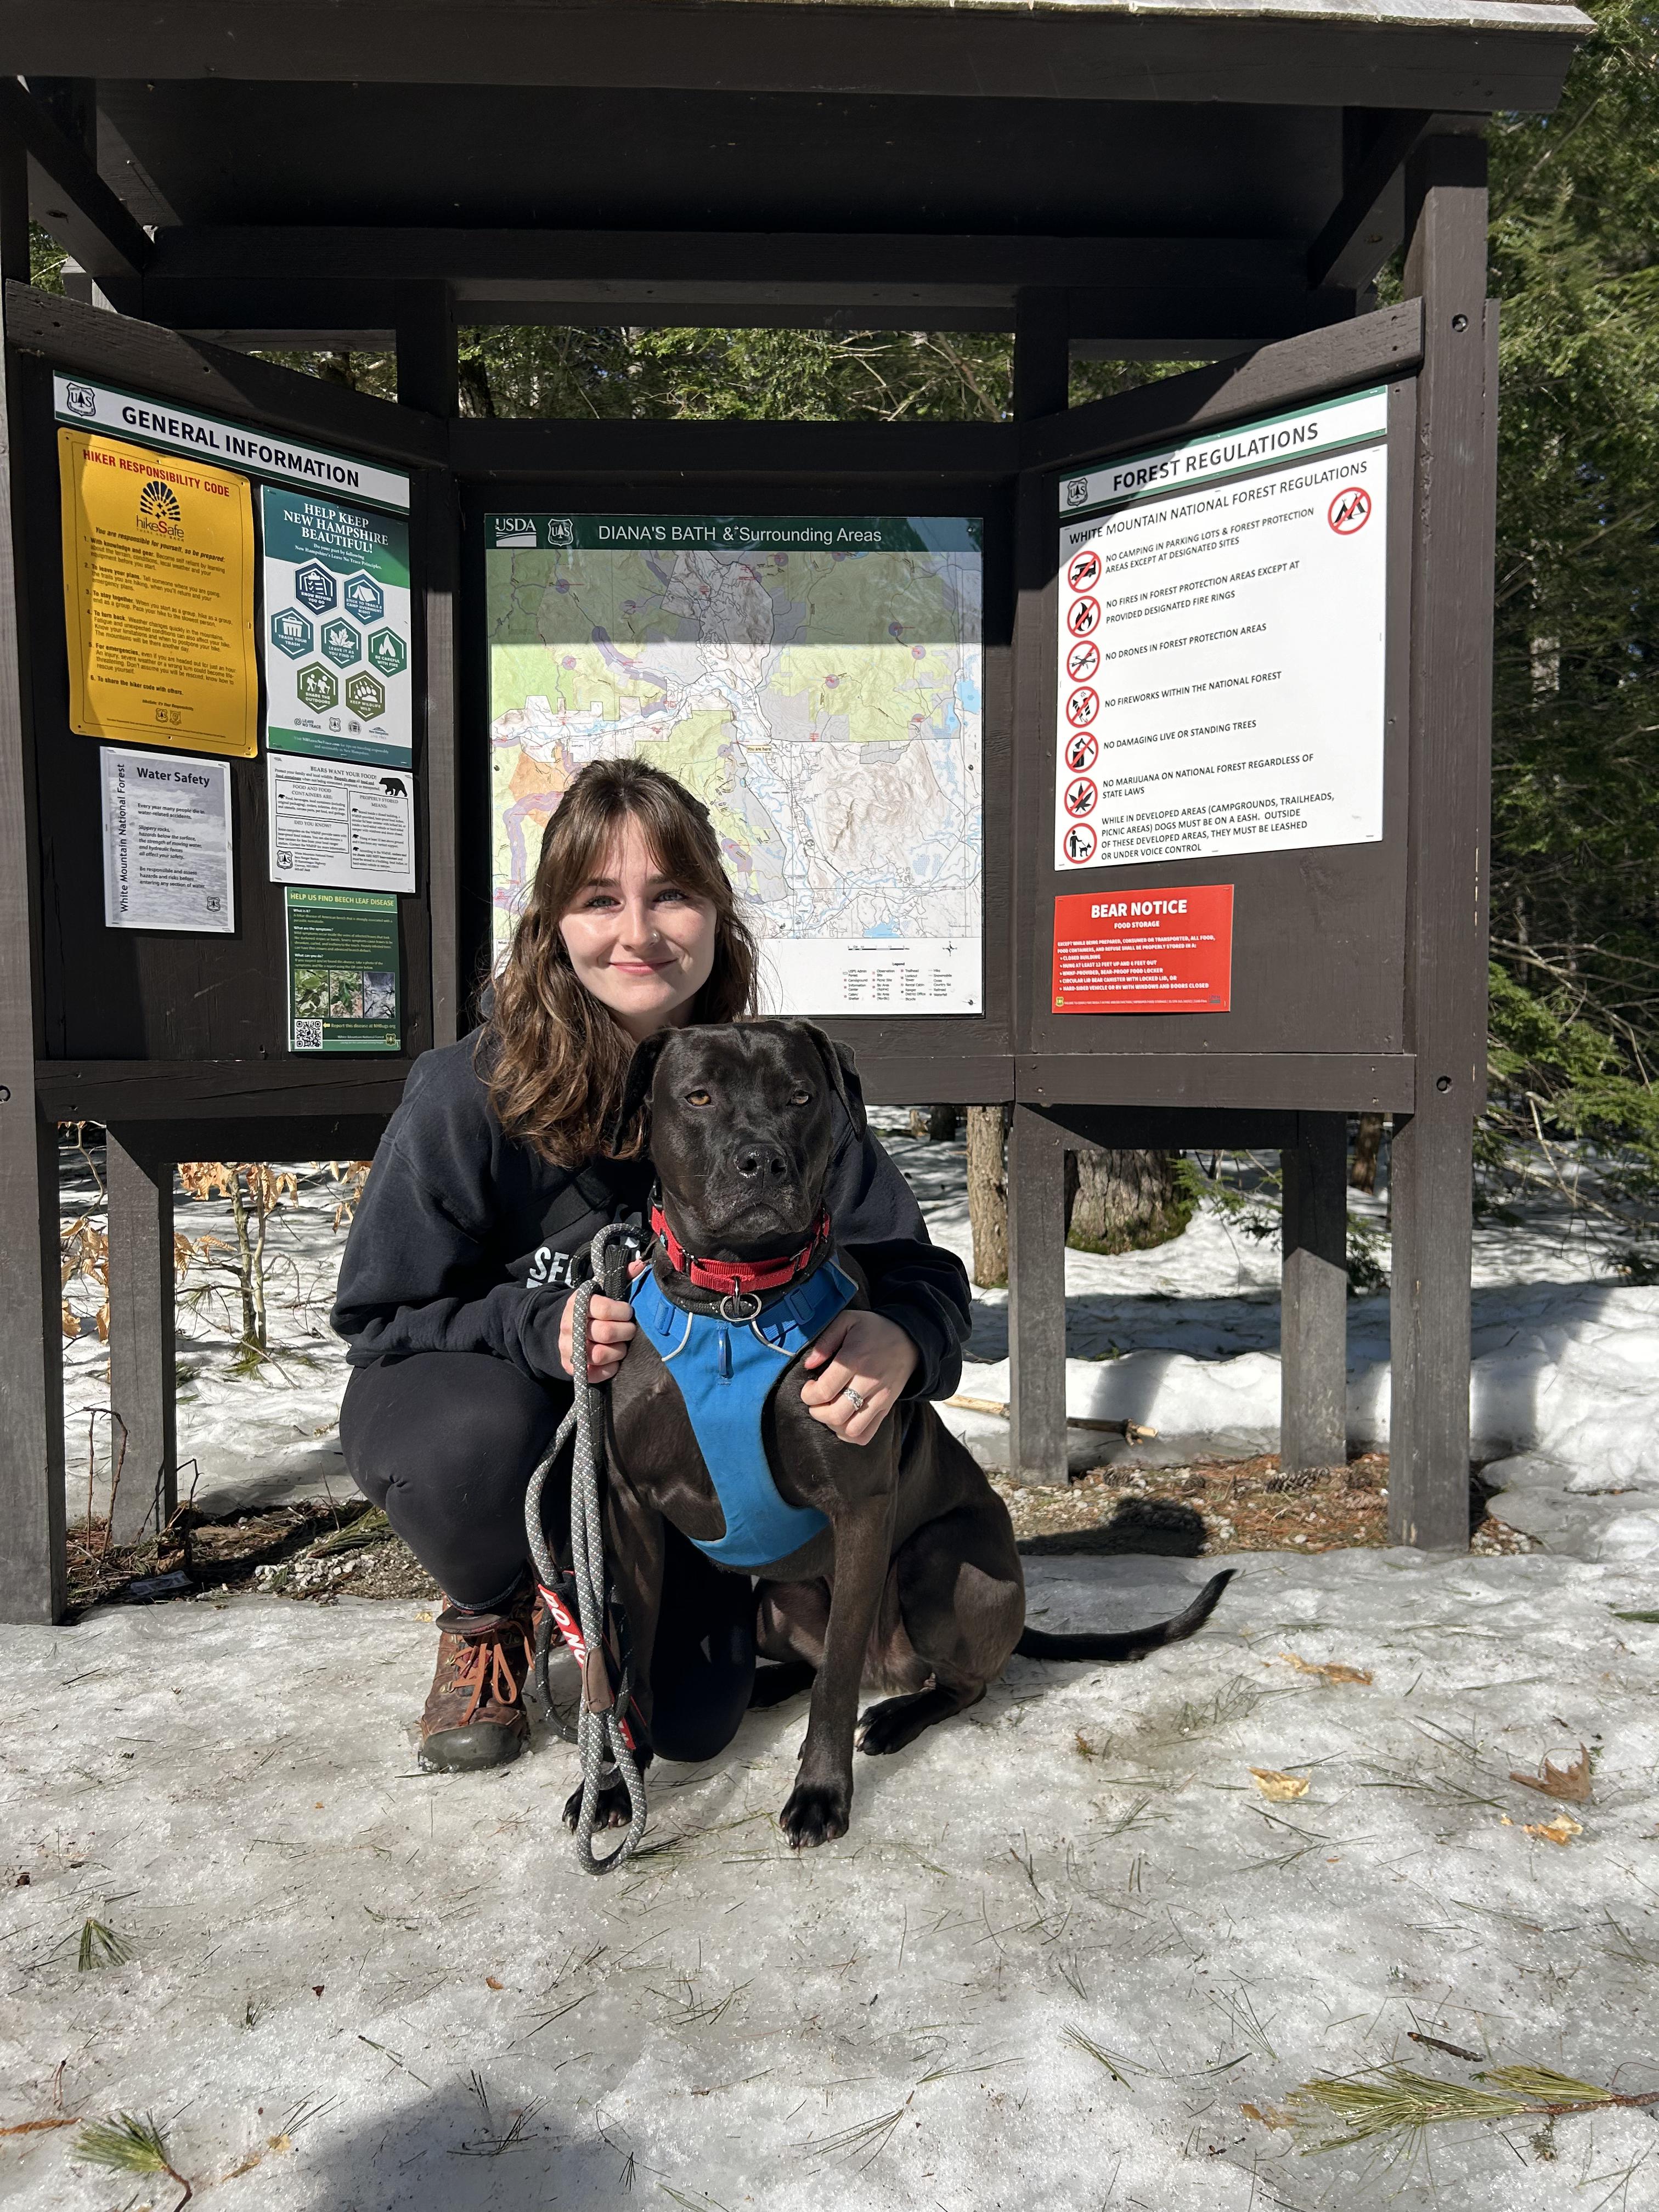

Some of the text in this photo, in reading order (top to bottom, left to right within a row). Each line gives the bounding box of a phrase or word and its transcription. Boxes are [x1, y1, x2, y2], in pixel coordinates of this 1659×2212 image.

[122, 406, 359, 488] GENERAL INFORMATION
[1114, 422, 1318, 492] FOREST REGULATIONS
[82, 449, 230, 497] HIKER RESPONSIBILITY CODE
[304, 503, 369, 528] HELP KEEP
[1069, 461, 1367, 544] WHITE MOUNTAIN NATIONAL FOREST REGULATIONS
[136, 515, 185, 538] hikeSafe
[284, 510, 388, 545] NEW HAMPSHIRE
[301, 526, 375, 554] BEAUTIFUL!
[495, 518, 537, 532] USDA
[599, 525, 882, 544] DIANA'S BATH & Surrounding Areas
[1106, 507, 1314, 562] NO CAMPING IN PARKING LOTS & FOREST PROTECTION
[1105, 536, 1239, 574] AREAS EXCEPT AT DESIGNATED SITES
[1107, 560, 1300, 608] NO FIRES IN FOREST PROTECTION AREAS EXCEPT AT
[1106, 590, 1235, 624] PROVIDED DESIGNATED FIRE RINGS
[1105, 623, 1266, 661] NO DRONES IN FOREST PROTECTION AREAS
[1105, 671, 1282, 707] NO FIREWORKS WITHIN THE NATIONAL FOREST
[1116, 734, 1158, 747] DAMAGING
[1160, 731, 1175, 741] LIVE
[1177, 730, 1189, 738] OR
[1190, 724, 1231, 736] STANDING
[1232, 720, 1256, 730] TREES
[137, 767, 210, 788] Water Safety
[1116, 774, 1160, 786] MARIJUANA
[1161, 771, 1173, 780] ON
[1176, 766, 1215, 778] NATIONAL
[1217, 762, 1246, 773] FOREST
[1248, 755, 1300, 769] REGARDLESS
[1302, 753, 1313, 762] OF
[1102, 815, 1124, 825] WHILE
[1136, 809, 1180, 821] DEVELOPED
[1181, 806, 1206, 816] AREAS
[1208, 798, 1278, 815] (CAMPGROUNDS,
[1280, 792, 1334, 805] TRAILHEADS,
[1103, 786, 1144, 799] STATE LAWS
[117, 764, 128, 912] White Mountain National Forest
[1102, 827, 1125, 837] PICNIC
[1126, 823, 1153, 834] AREAS)
[1155, 822, 1176, 831] DOGS
[1178, 819, 1201, 828] MUST
[1203, 818, 1212, 826] BE
[1215, 816, 1227, 825] ON
[1237, 813, 1260, 822] EASH.
[1265, 809, 1300, 820] OUTSIDE
[1112, 838, 1134, 847] THESE
[1136, 833, 1180, 845] DEVELOPED
[1182, 831, 1209, 840] AREAS,
[1211, 828, 1231, 837] THEY
[1233, 826, 1257, 835] MUST
[1259, 825, 1268, 833] BE
[1271, 821, 1307, 832] LEASHED
[1101, 844, 1201, 860] OR UNDER VOICE CONTROL
[1091, 899, 1187, 918] BEAR NOTICE
